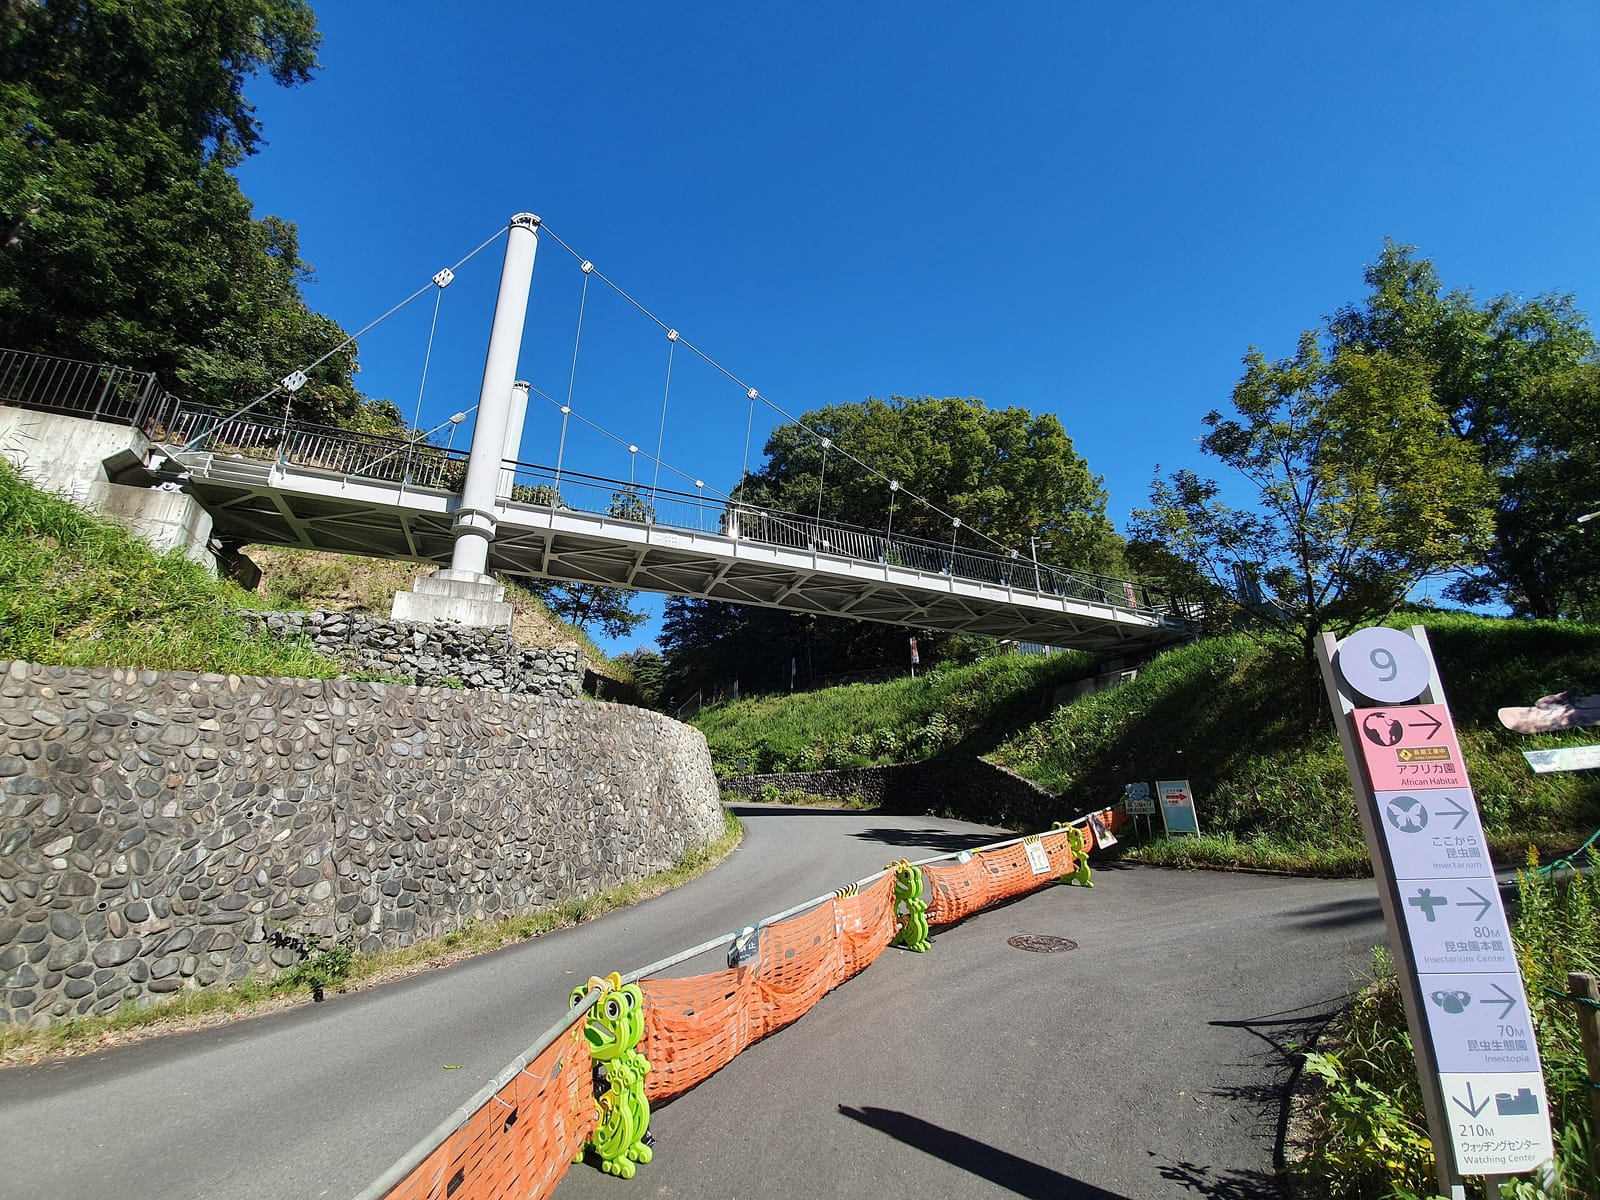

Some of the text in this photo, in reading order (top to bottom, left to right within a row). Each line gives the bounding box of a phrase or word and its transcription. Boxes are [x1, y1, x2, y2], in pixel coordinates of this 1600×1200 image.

[1369, 648, 1397, 682] 9
[1396, 763, 1456, 775] アフリカ園
[1401, 777, 1458, 786] African Habitat
[1432, 835, 1477, 847] ここから
[1446, 847, 1481, 859] 昆虫園
[1432, 861, 1482, 870] Insectarium
[1473, 926, 1501, 938] 80M
[1445, 940, 1504, 952] 昆虫園本館
[1424, 954, 1506, 963] Insectarium Center
[1496, 1024, 1525, 1037] 70M
[1467, 1039, 1528, 1052] 昆虫生態園
[1484, 1055, 1530, 1064] Insectopia
[1459, 1124, 1495, 1137] 210M
[1461, 1139, 1541, 1152] ウォッチングセンター
[1463, 1154, 1536, 1164] Watching Center
